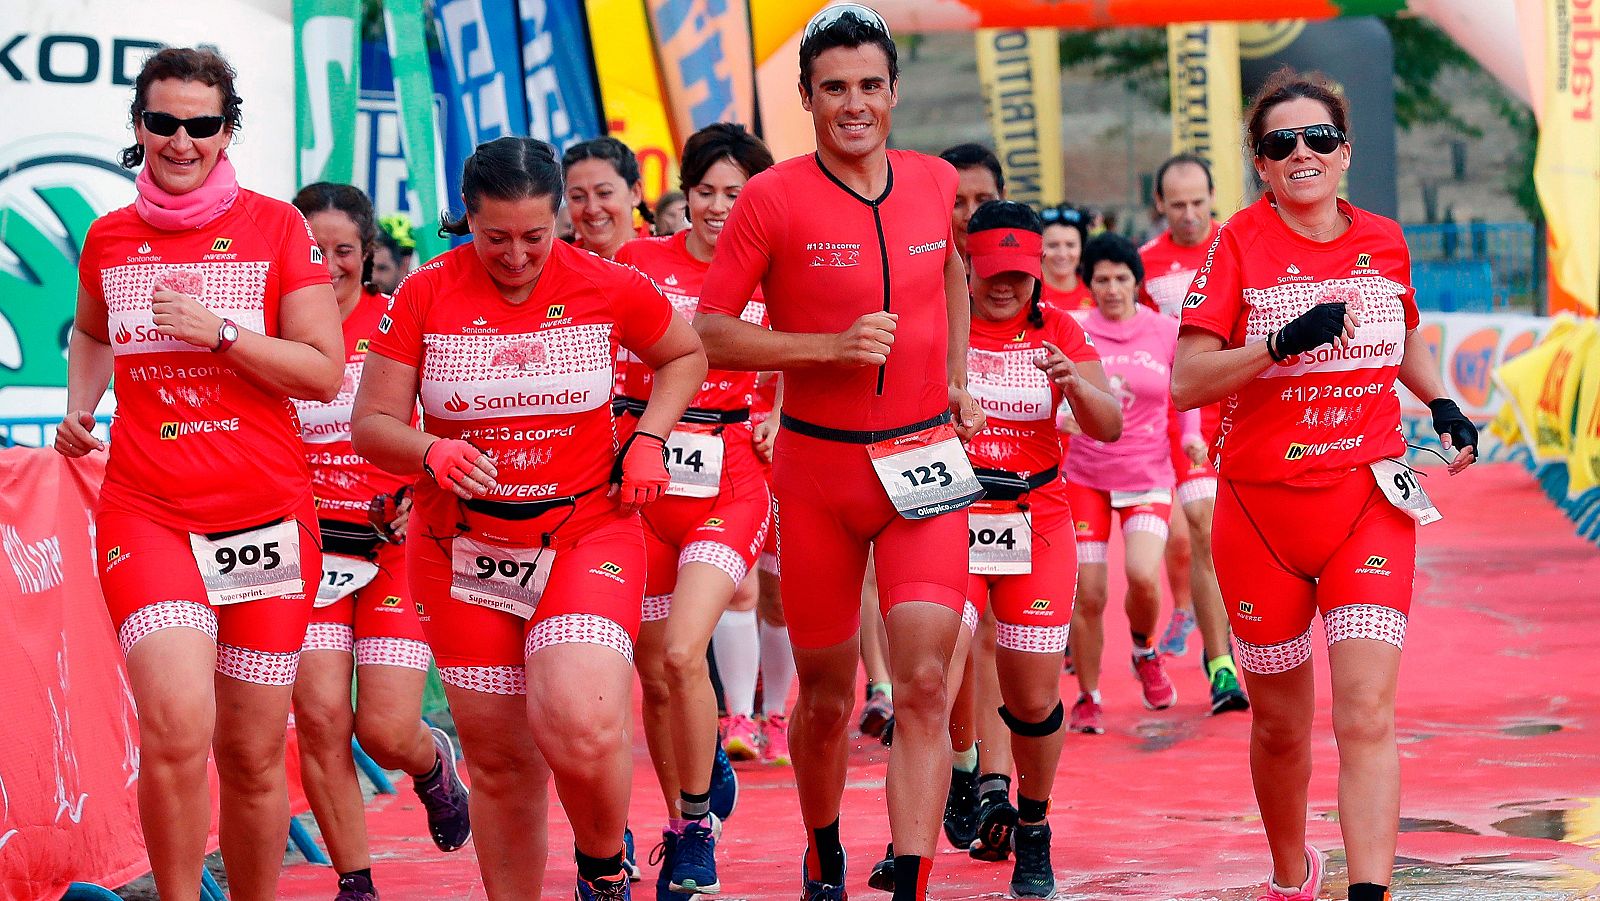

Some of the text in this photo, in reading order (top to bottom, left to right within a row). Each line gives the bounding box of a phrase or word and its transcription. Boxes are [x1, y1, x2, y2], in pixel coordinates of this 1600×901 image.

[213, 239, 231, 250] IN
[126, 254, 162, 263] Santander
[311, 247, 323, 262] IN
[1357, 255, 1370, 267] IN
[393, 260, 445, 296] Santander
[1277, 274, 1314, 284] Santander
[1185, 294, 1204, 306] IN
[548, 306, 564, 318] IN
[380, 318, 391, 331] IN
[540, 317, 572, 329] INVERSE
[461, 326, 499, 334] Santander
[474, 388, 591, 411] Santander
[163, 417, 240, 438] IN INVERSE
[1287, 434, 1364, 458] IN INVERSE
[664, 447, 704, 473] 14
[901, 461, 953, 487] 123
[108, 547, 120, 561] IN
[214, 541, 281, 576] 905
[602, 562, 620, 574] IN
[1367, 557, 1385, 567] IN
[475, 555, 538, 589] 907
[588, 568, 626, 584] INVERSE
[1354, 568, 1392, 577] INVERSE
[320, 570, 354, 587] 12
[1033, 600, 1049, 609] IN
[1240, 602, 1252, 613] IN
